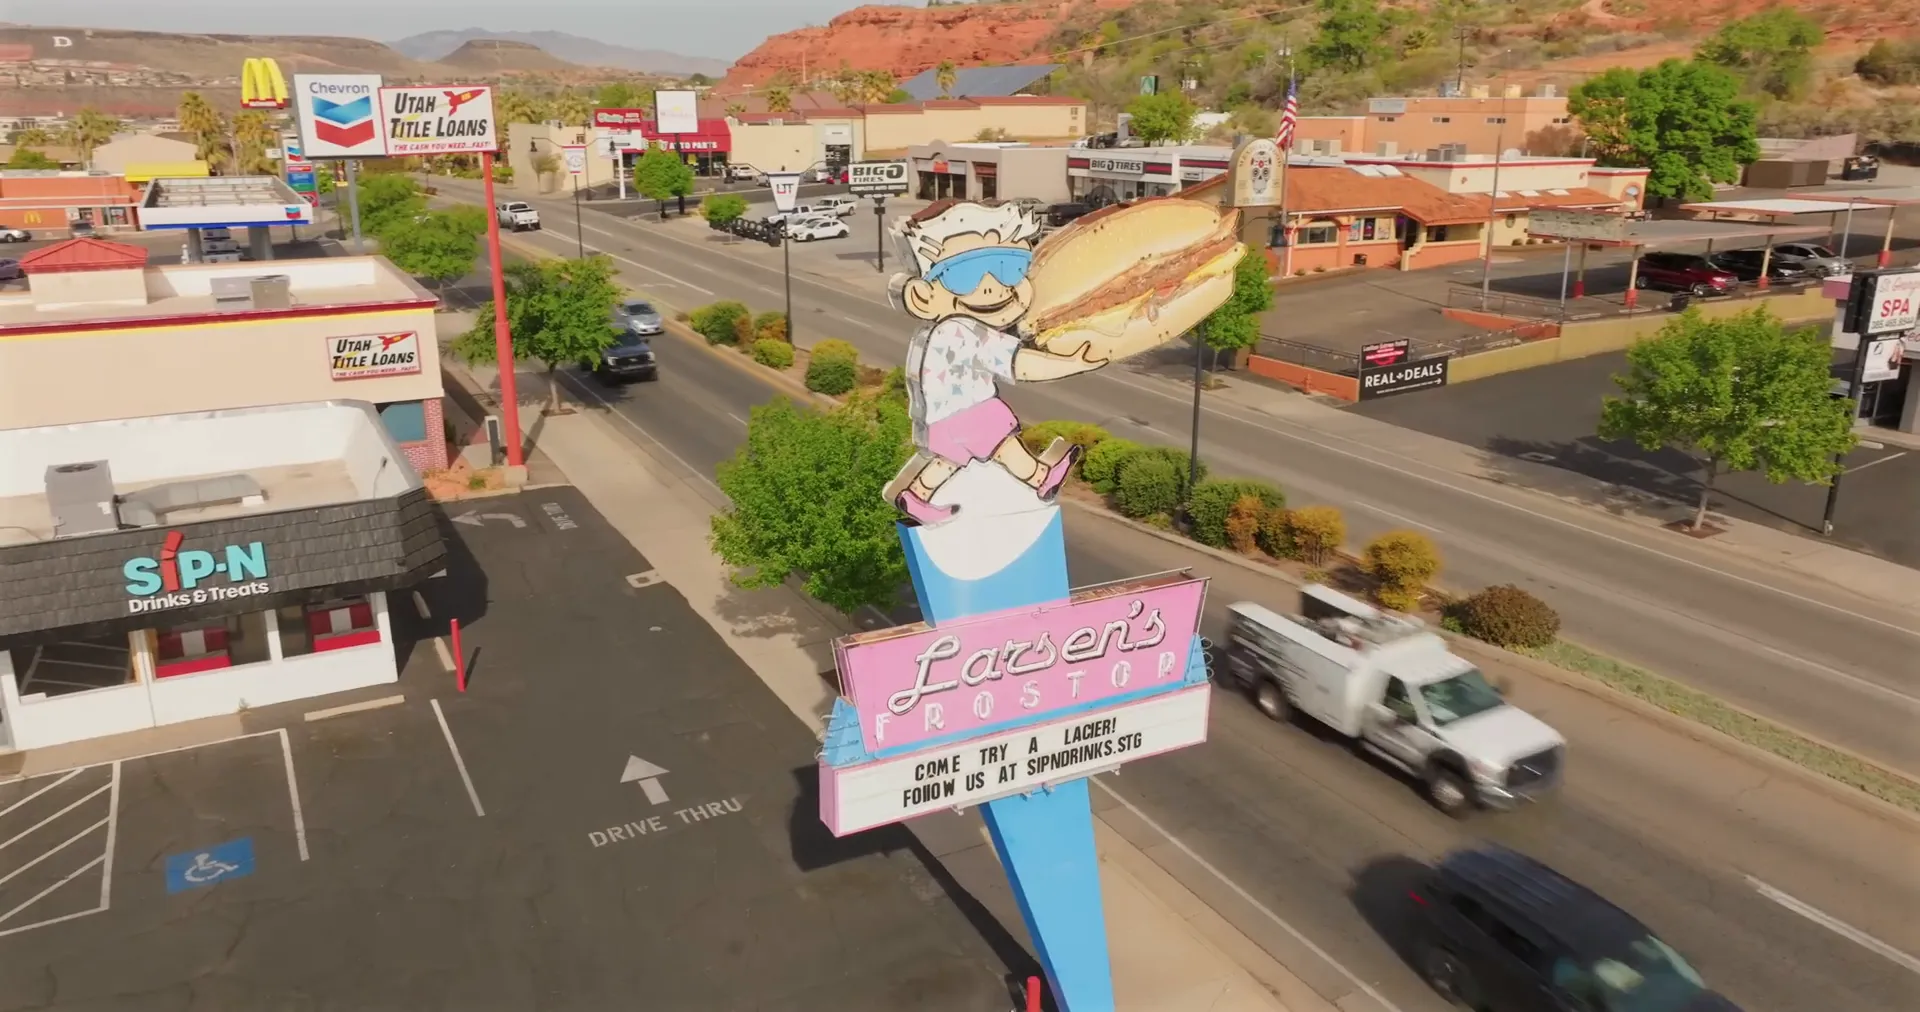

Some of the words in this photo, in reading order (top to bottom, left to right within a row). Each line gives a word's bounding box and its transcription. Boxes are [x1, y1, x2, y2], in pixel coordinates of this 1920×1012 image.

[309, 82, 370, 94] Chevron
[394, 92, 436, 114] UTAH
[390, 118, 432, 138] TITLE
[436, 116, 487, 137] LOANS
[409, 143, 429, 151] CASH
[431, 142, 447, 150] YOU
[853, 166, 885, 176] BIG
[1091, 160, 1106, 169] BIG
[1115, 161, 1141, 171] TIRES
[1881, 298, 1910, 318] SPA
[336, 339, 372, 353] UTAH
[333, 355, 367, 369] TITLE
[371, 352, 415, 366] LOANS
[1365, 372, 1397, 388] REAL
[1404, 363, 1443, 381] DEALS
[129, 593, 192, 613] Drinks
[193, 589, 207, 603] &
[208, 582, 270, 600] Treats
[888, 599, 1166, 715] Larsen's
[874, 650, 1177, 744] FROSTOP
[915, 755, 961, 782] COME
[980, 743, 1008, 765] TRY
[1028, 736, 1038, 754] A
[1064, 717, 1117, 745] LACIER!
[966, 771, 985, 792] US
[998, 763, 1017, 784] AT
[1027, 732, 1143, 776] SIPNDRINKS.STG
[588, 815, 668, 848] DRIVE
[673, 797, 743, 824] THRU
